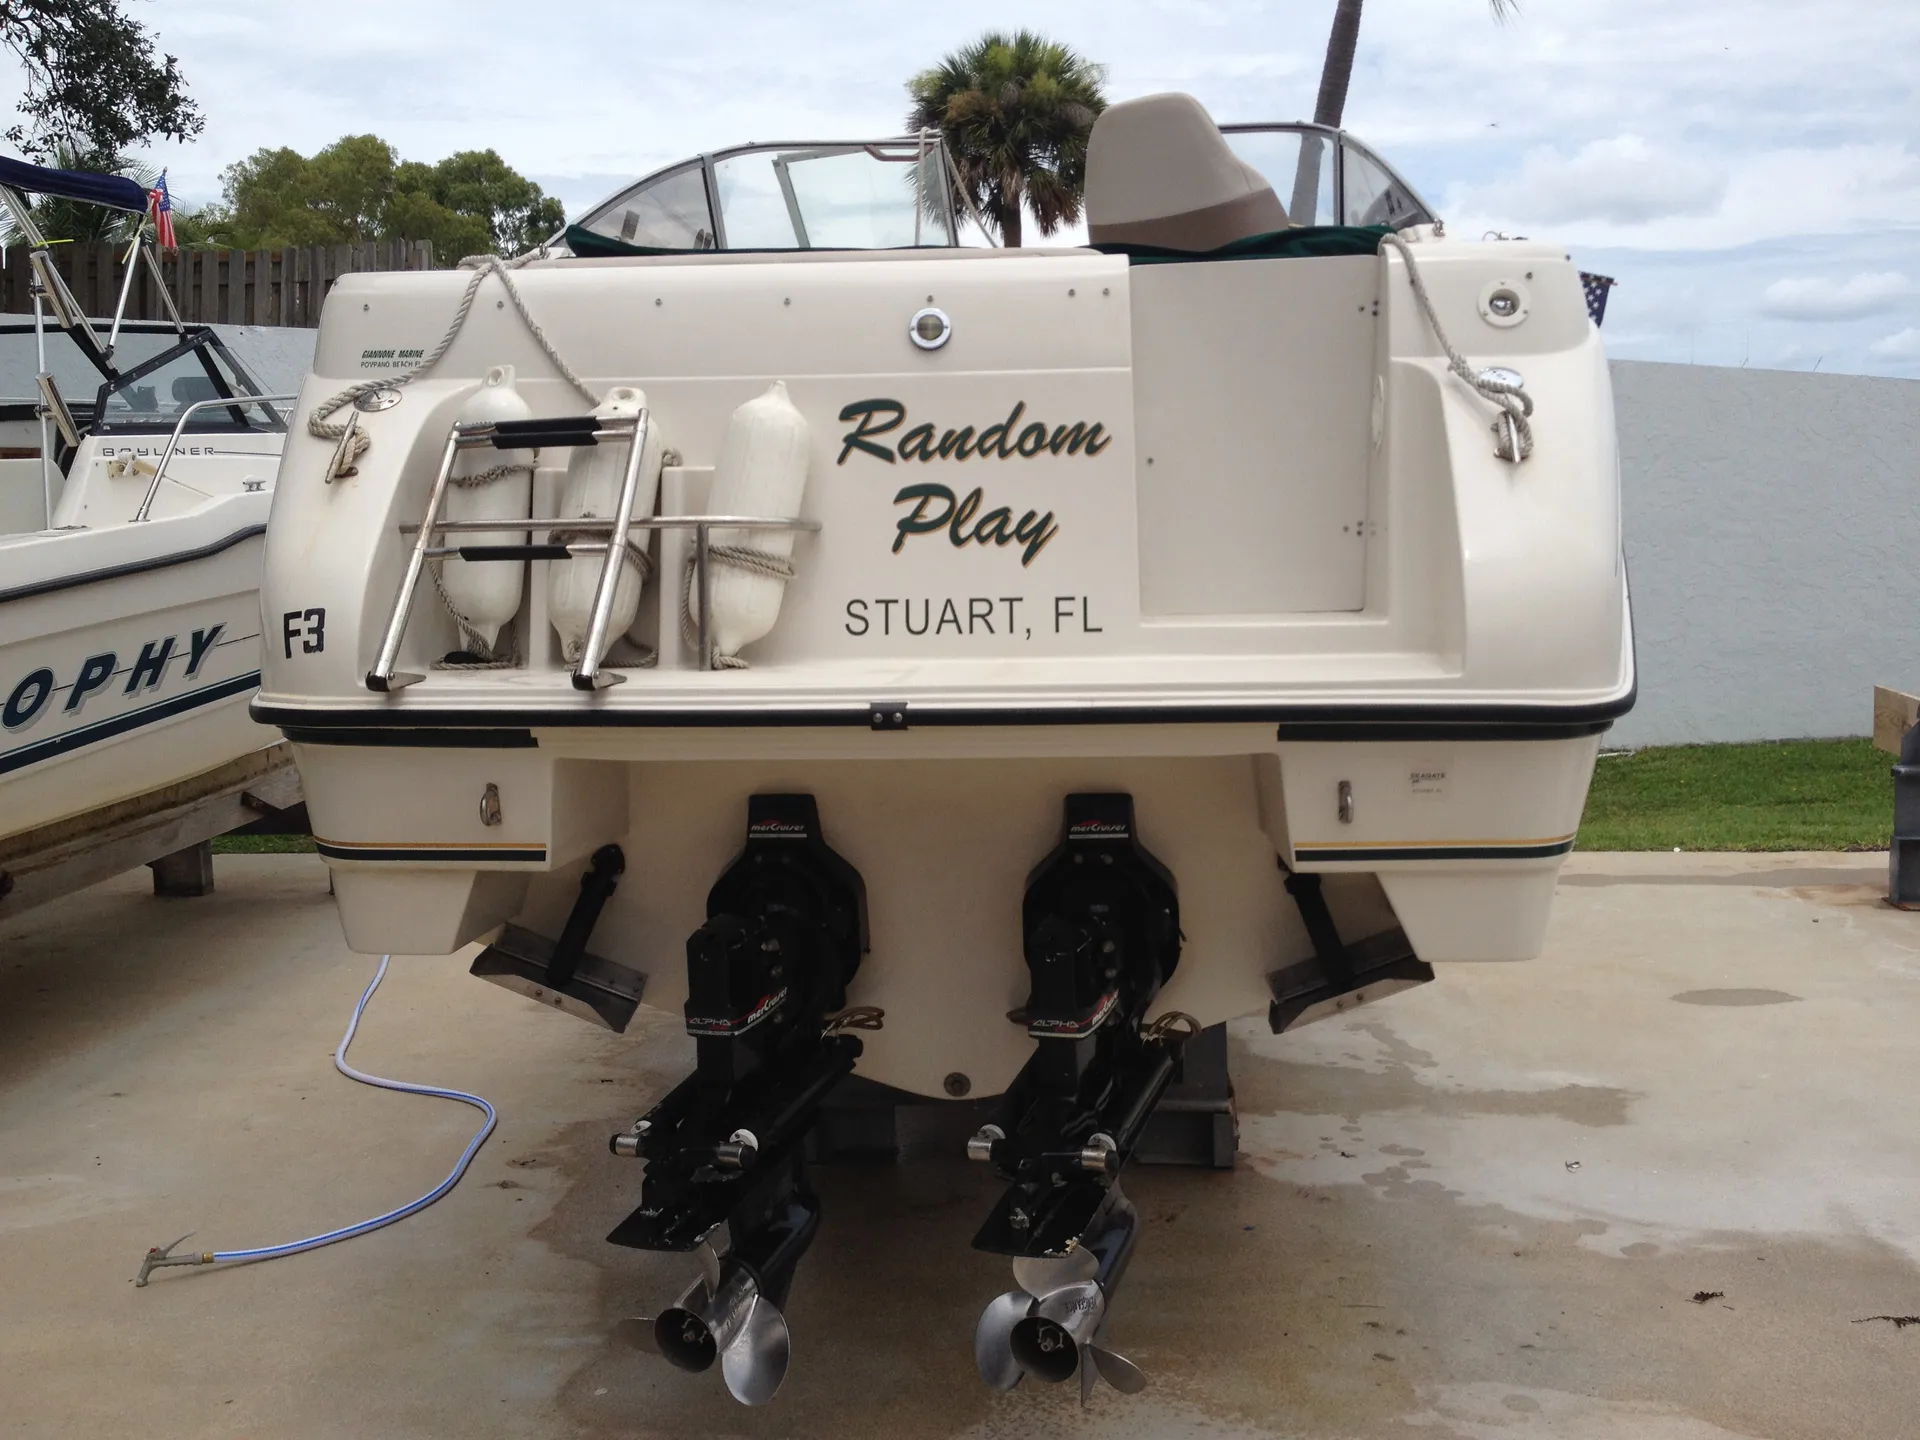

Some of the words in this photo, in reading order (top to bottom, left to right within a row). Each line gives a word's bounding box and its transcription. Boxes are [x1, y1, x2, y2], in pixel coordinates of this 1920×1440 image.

[397, 349, 425, 359] MARINE
[392, 360, 413, 368] BEACH
[836, 398, 1113, 467] Random
[102, 447, 215, 457] BYLNER
[891, 482, 1060, 568] Play
[845, 597, 1032, 640] STUART,
[1054, 596, 1104, 633] FL
[283, 607, 326, 660] F3
[1, 621, 227, 732] OPHY
[750, 822, 805, 833] merCruiser
[688, 1017, 732, 1027] ALPHA
[1032, 1019, 1080, 1028] ALPHA
